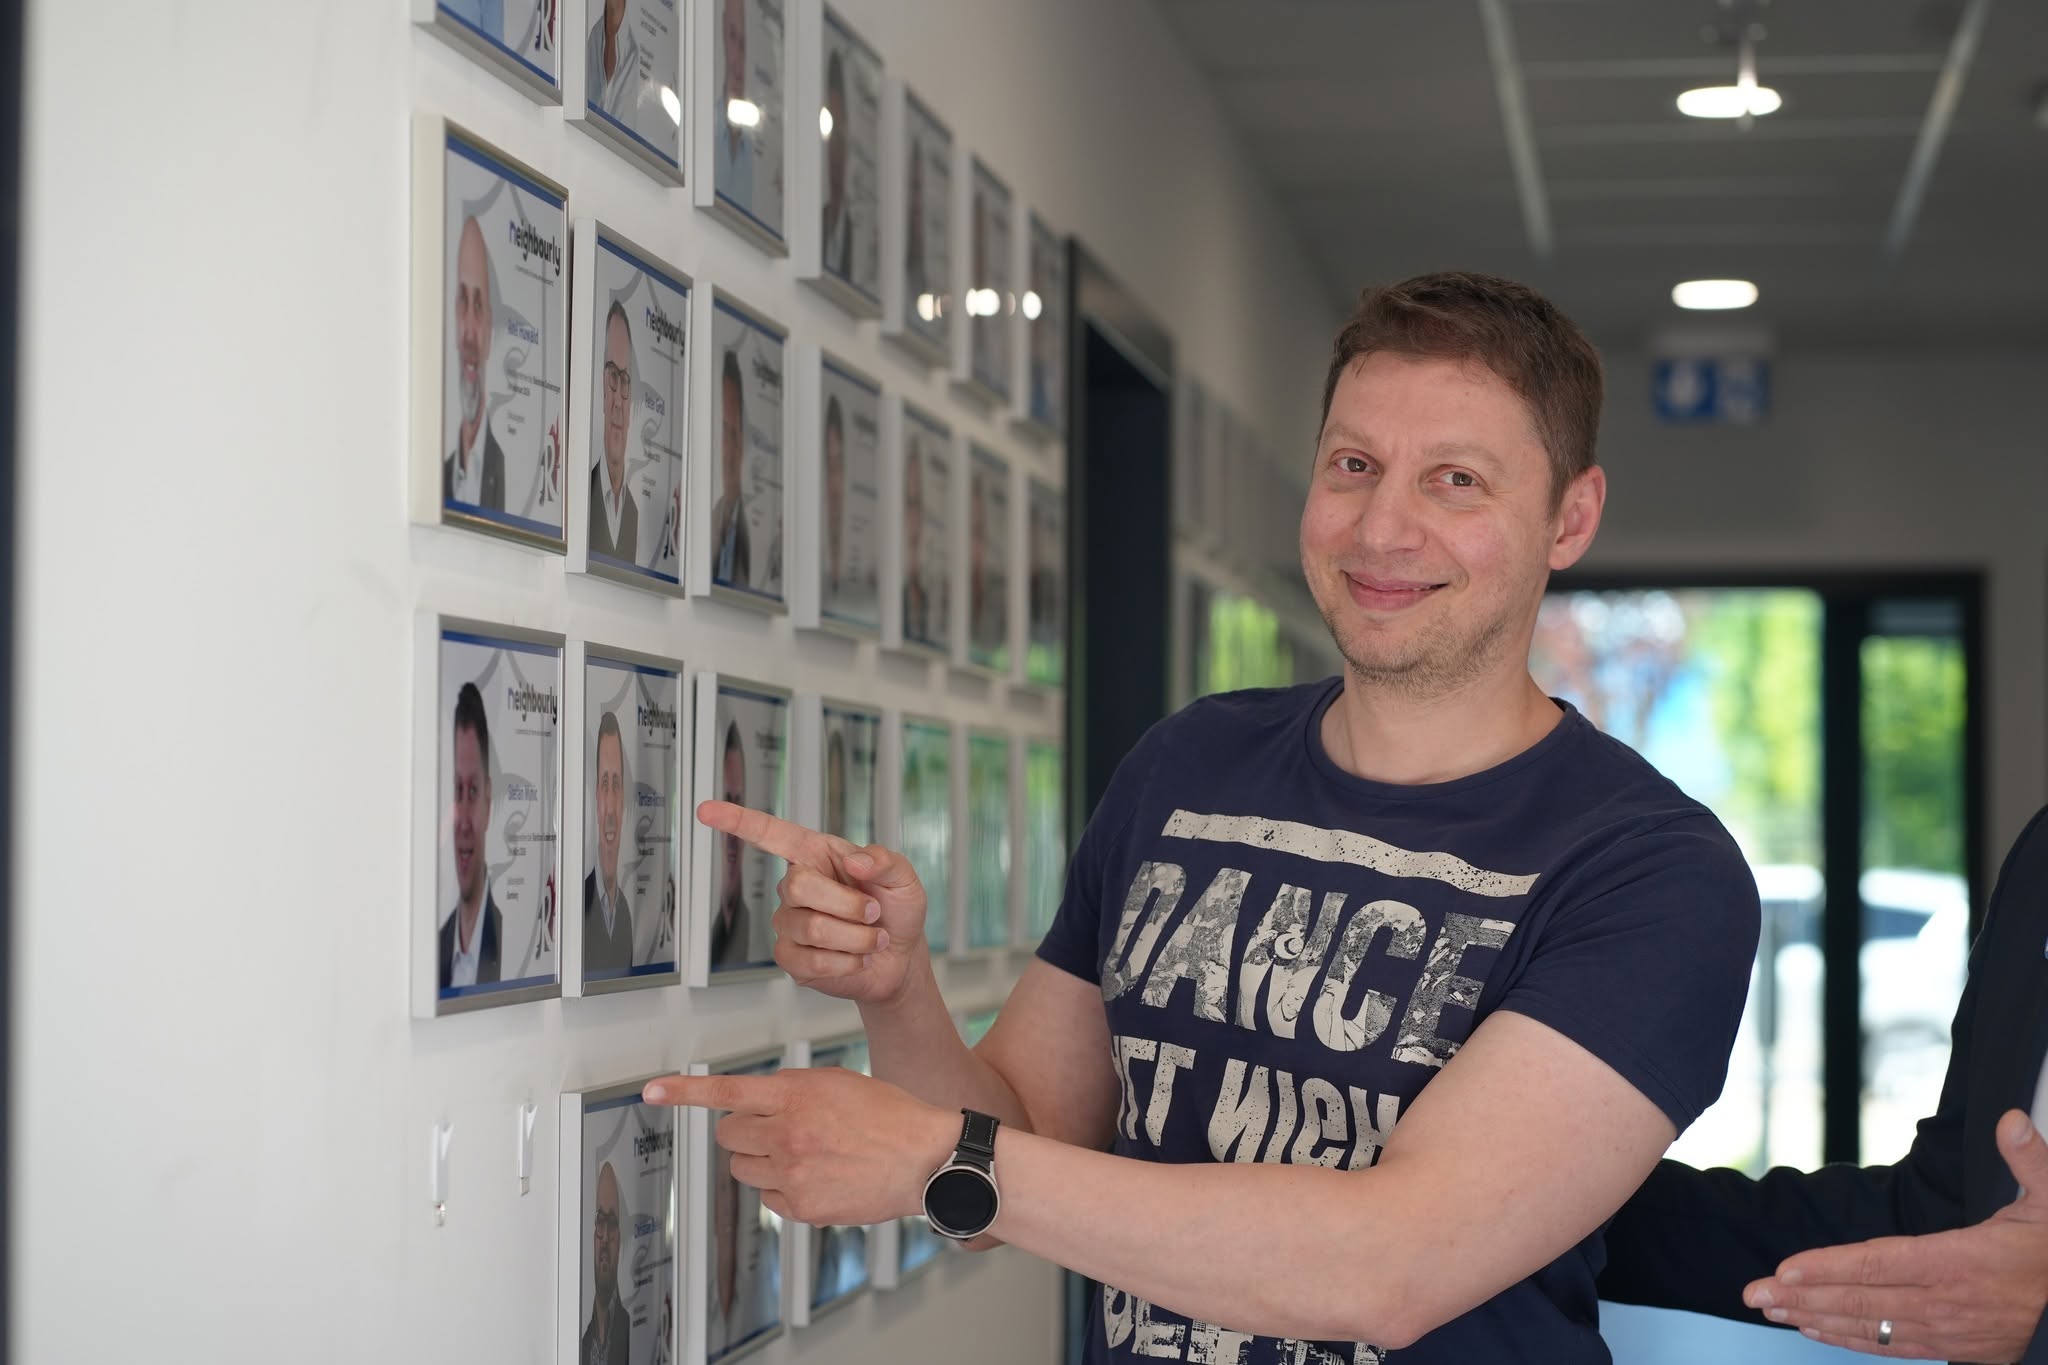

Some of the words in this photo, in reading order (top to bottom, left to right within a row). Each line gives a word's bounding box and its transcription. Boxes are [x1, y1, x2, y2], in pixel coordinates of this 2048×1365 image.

[509, 219, 560, 277] neighbourly
[508, 682, 558, 726] neighbourly
[1102, 861, 1516, 1069] DANCE
